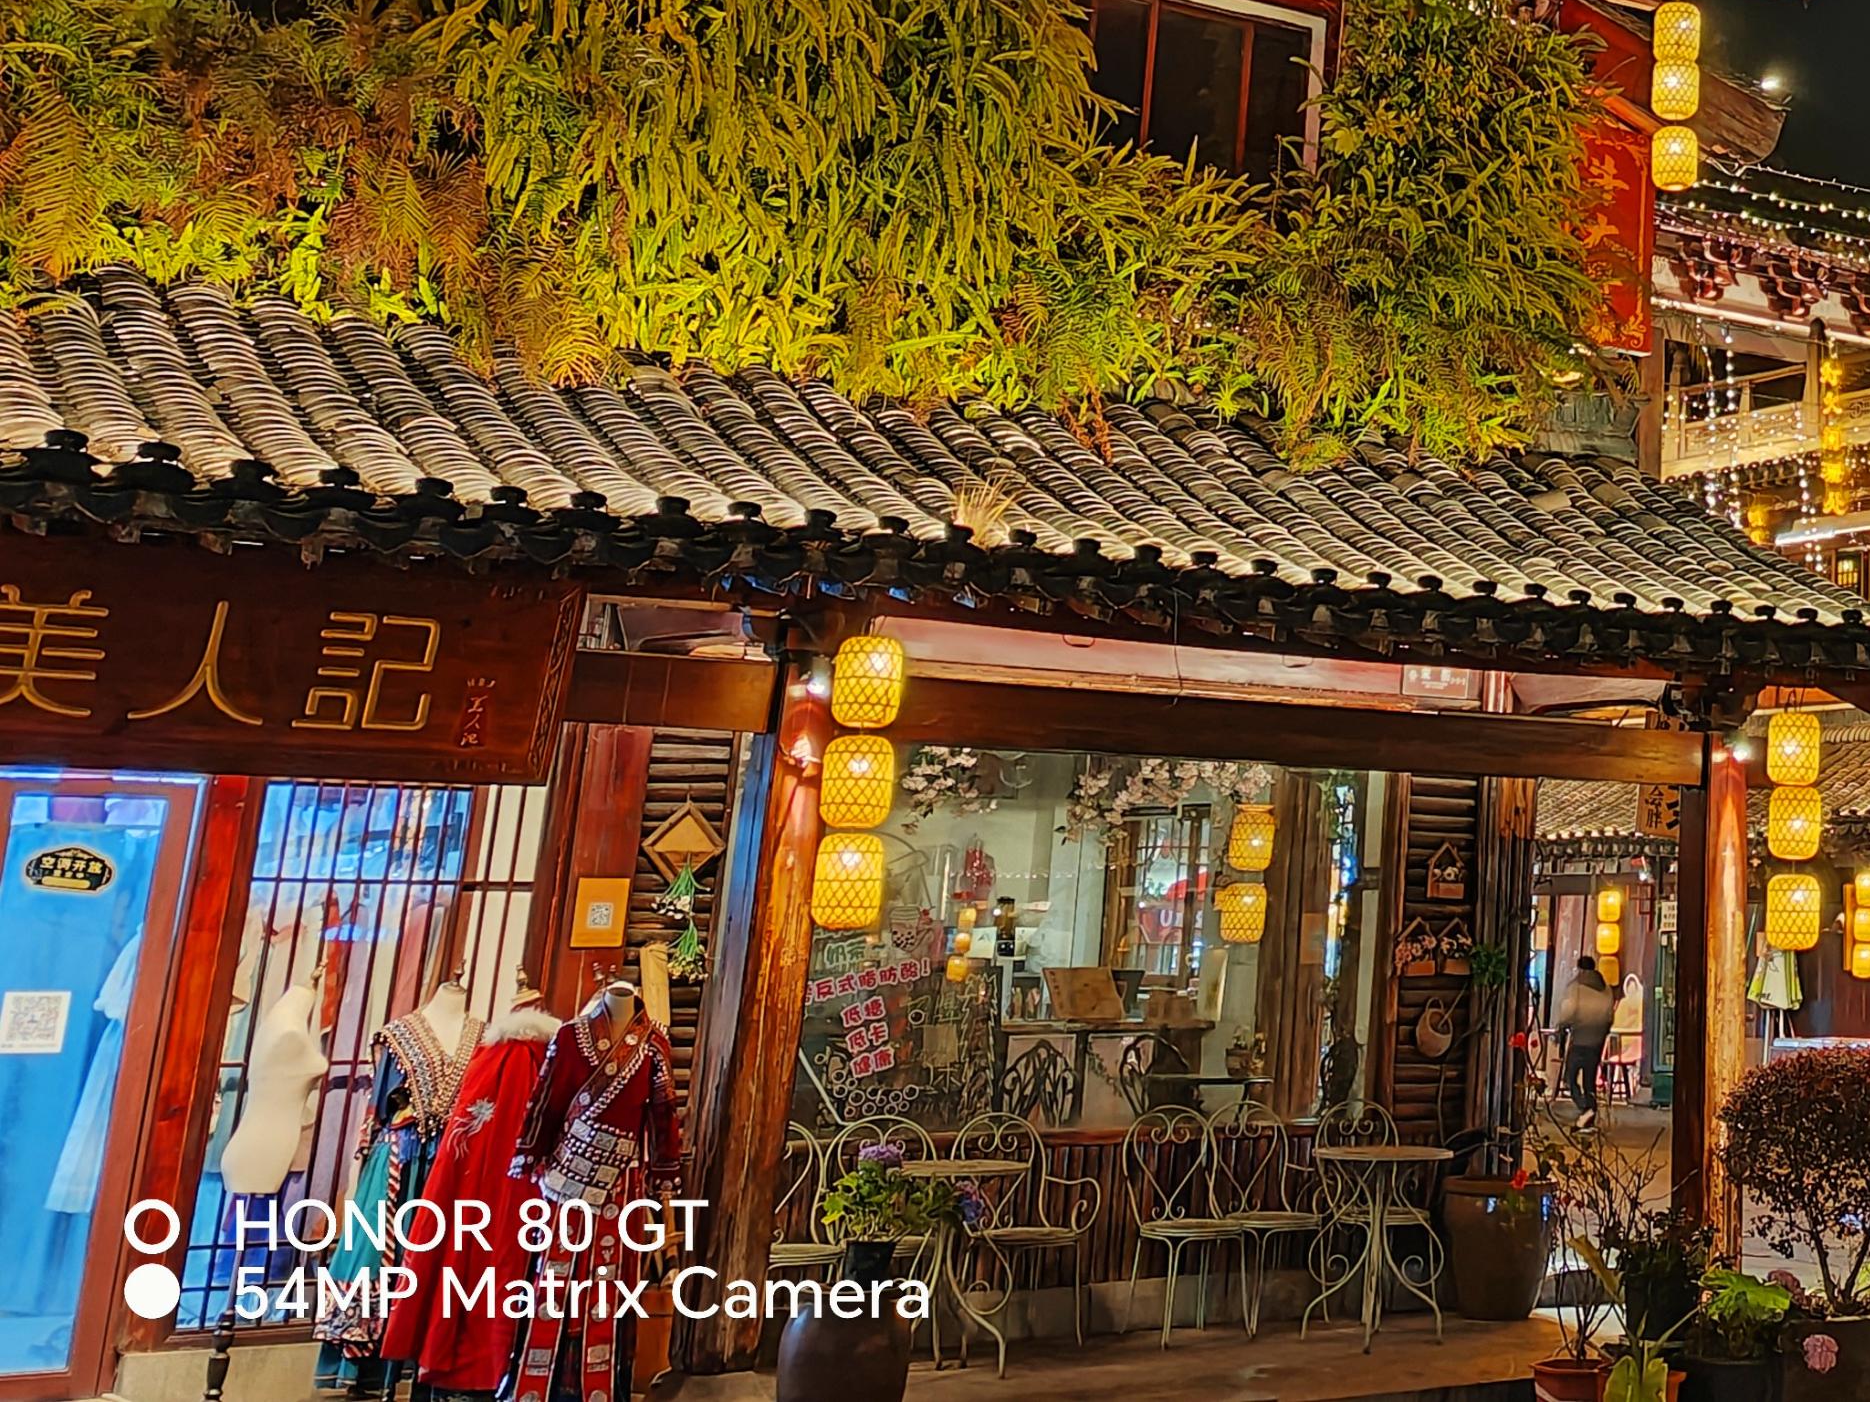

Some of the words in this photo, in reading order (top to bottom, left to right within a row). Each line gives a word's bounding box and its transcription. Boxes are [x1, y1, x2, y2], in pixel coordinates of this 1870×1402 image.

[40, 856, 103, 874] 空调开放
[841, 996, 886, 1027] 低糖
[847, 1022, 888, 1053] 低卡
[850, 1047, 894, 1078] 健康
